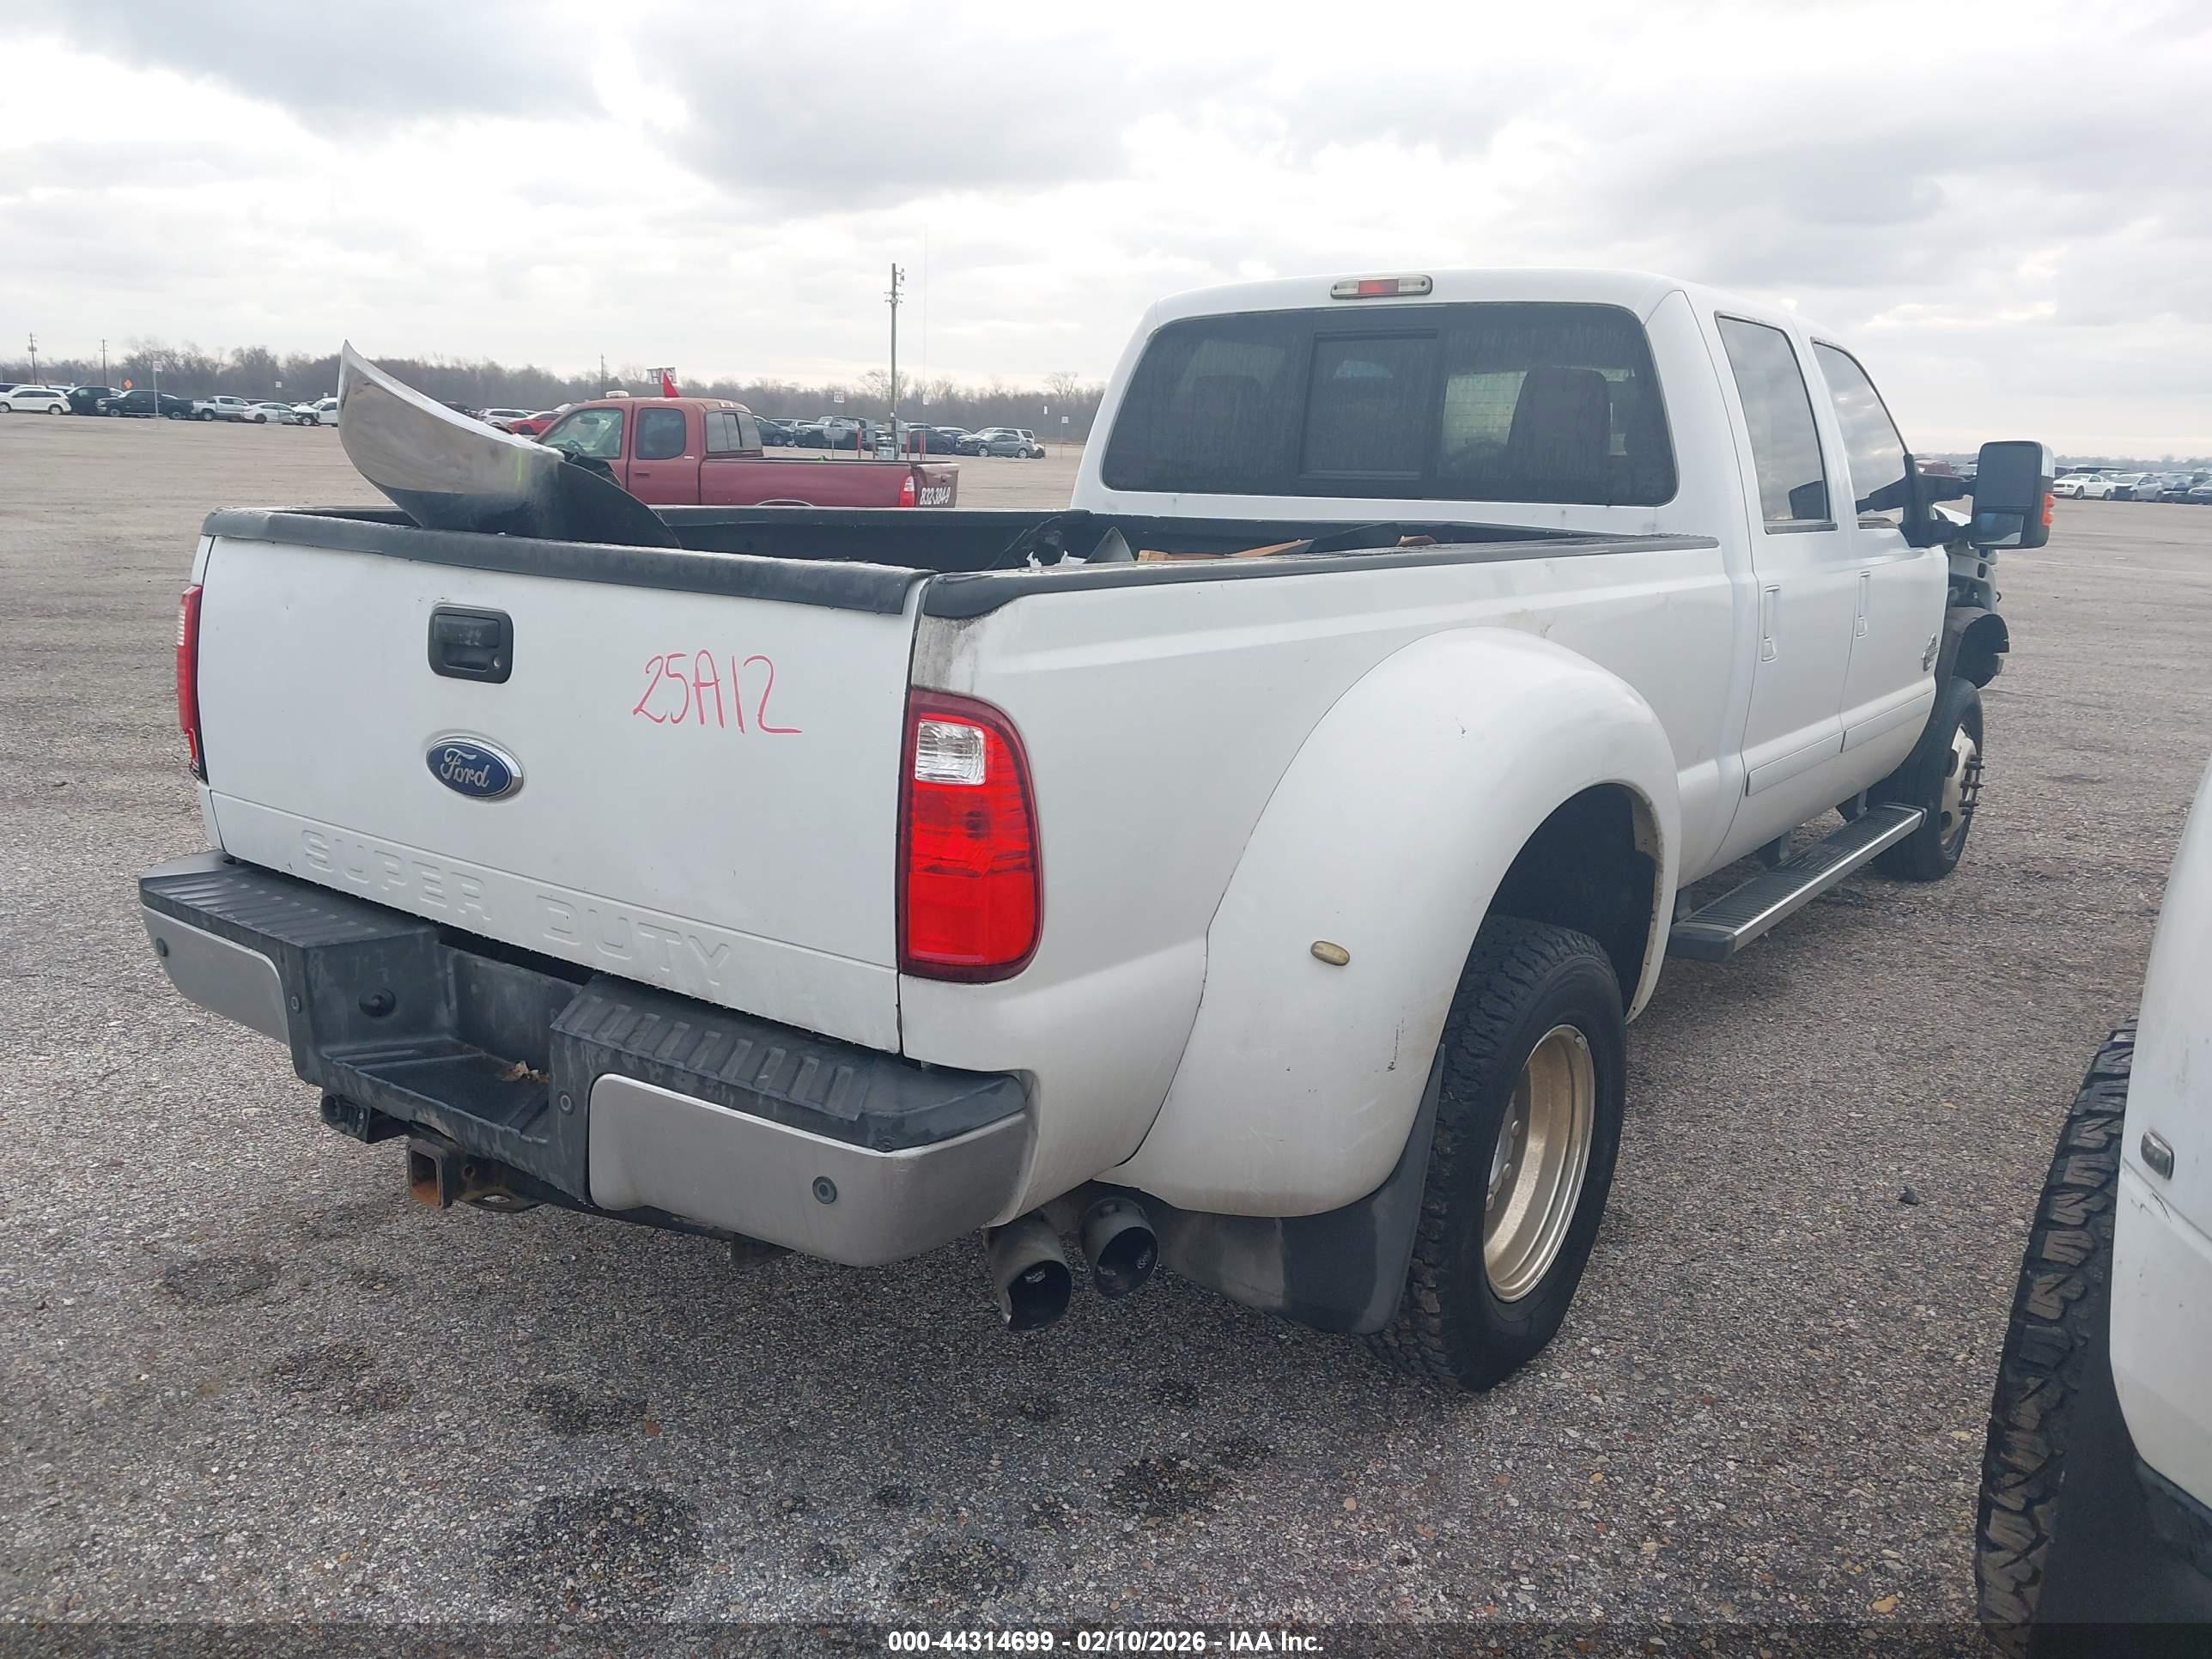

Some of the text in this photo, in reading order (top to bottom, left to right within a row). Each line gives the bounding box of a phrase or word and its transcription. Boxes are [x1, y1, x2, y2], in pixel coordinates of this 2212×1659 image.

[633, 649, 802, 734] 25A12
[440, 747, 490, 787] Ford
[301, 830, 730, 987] SUPER DUTY
